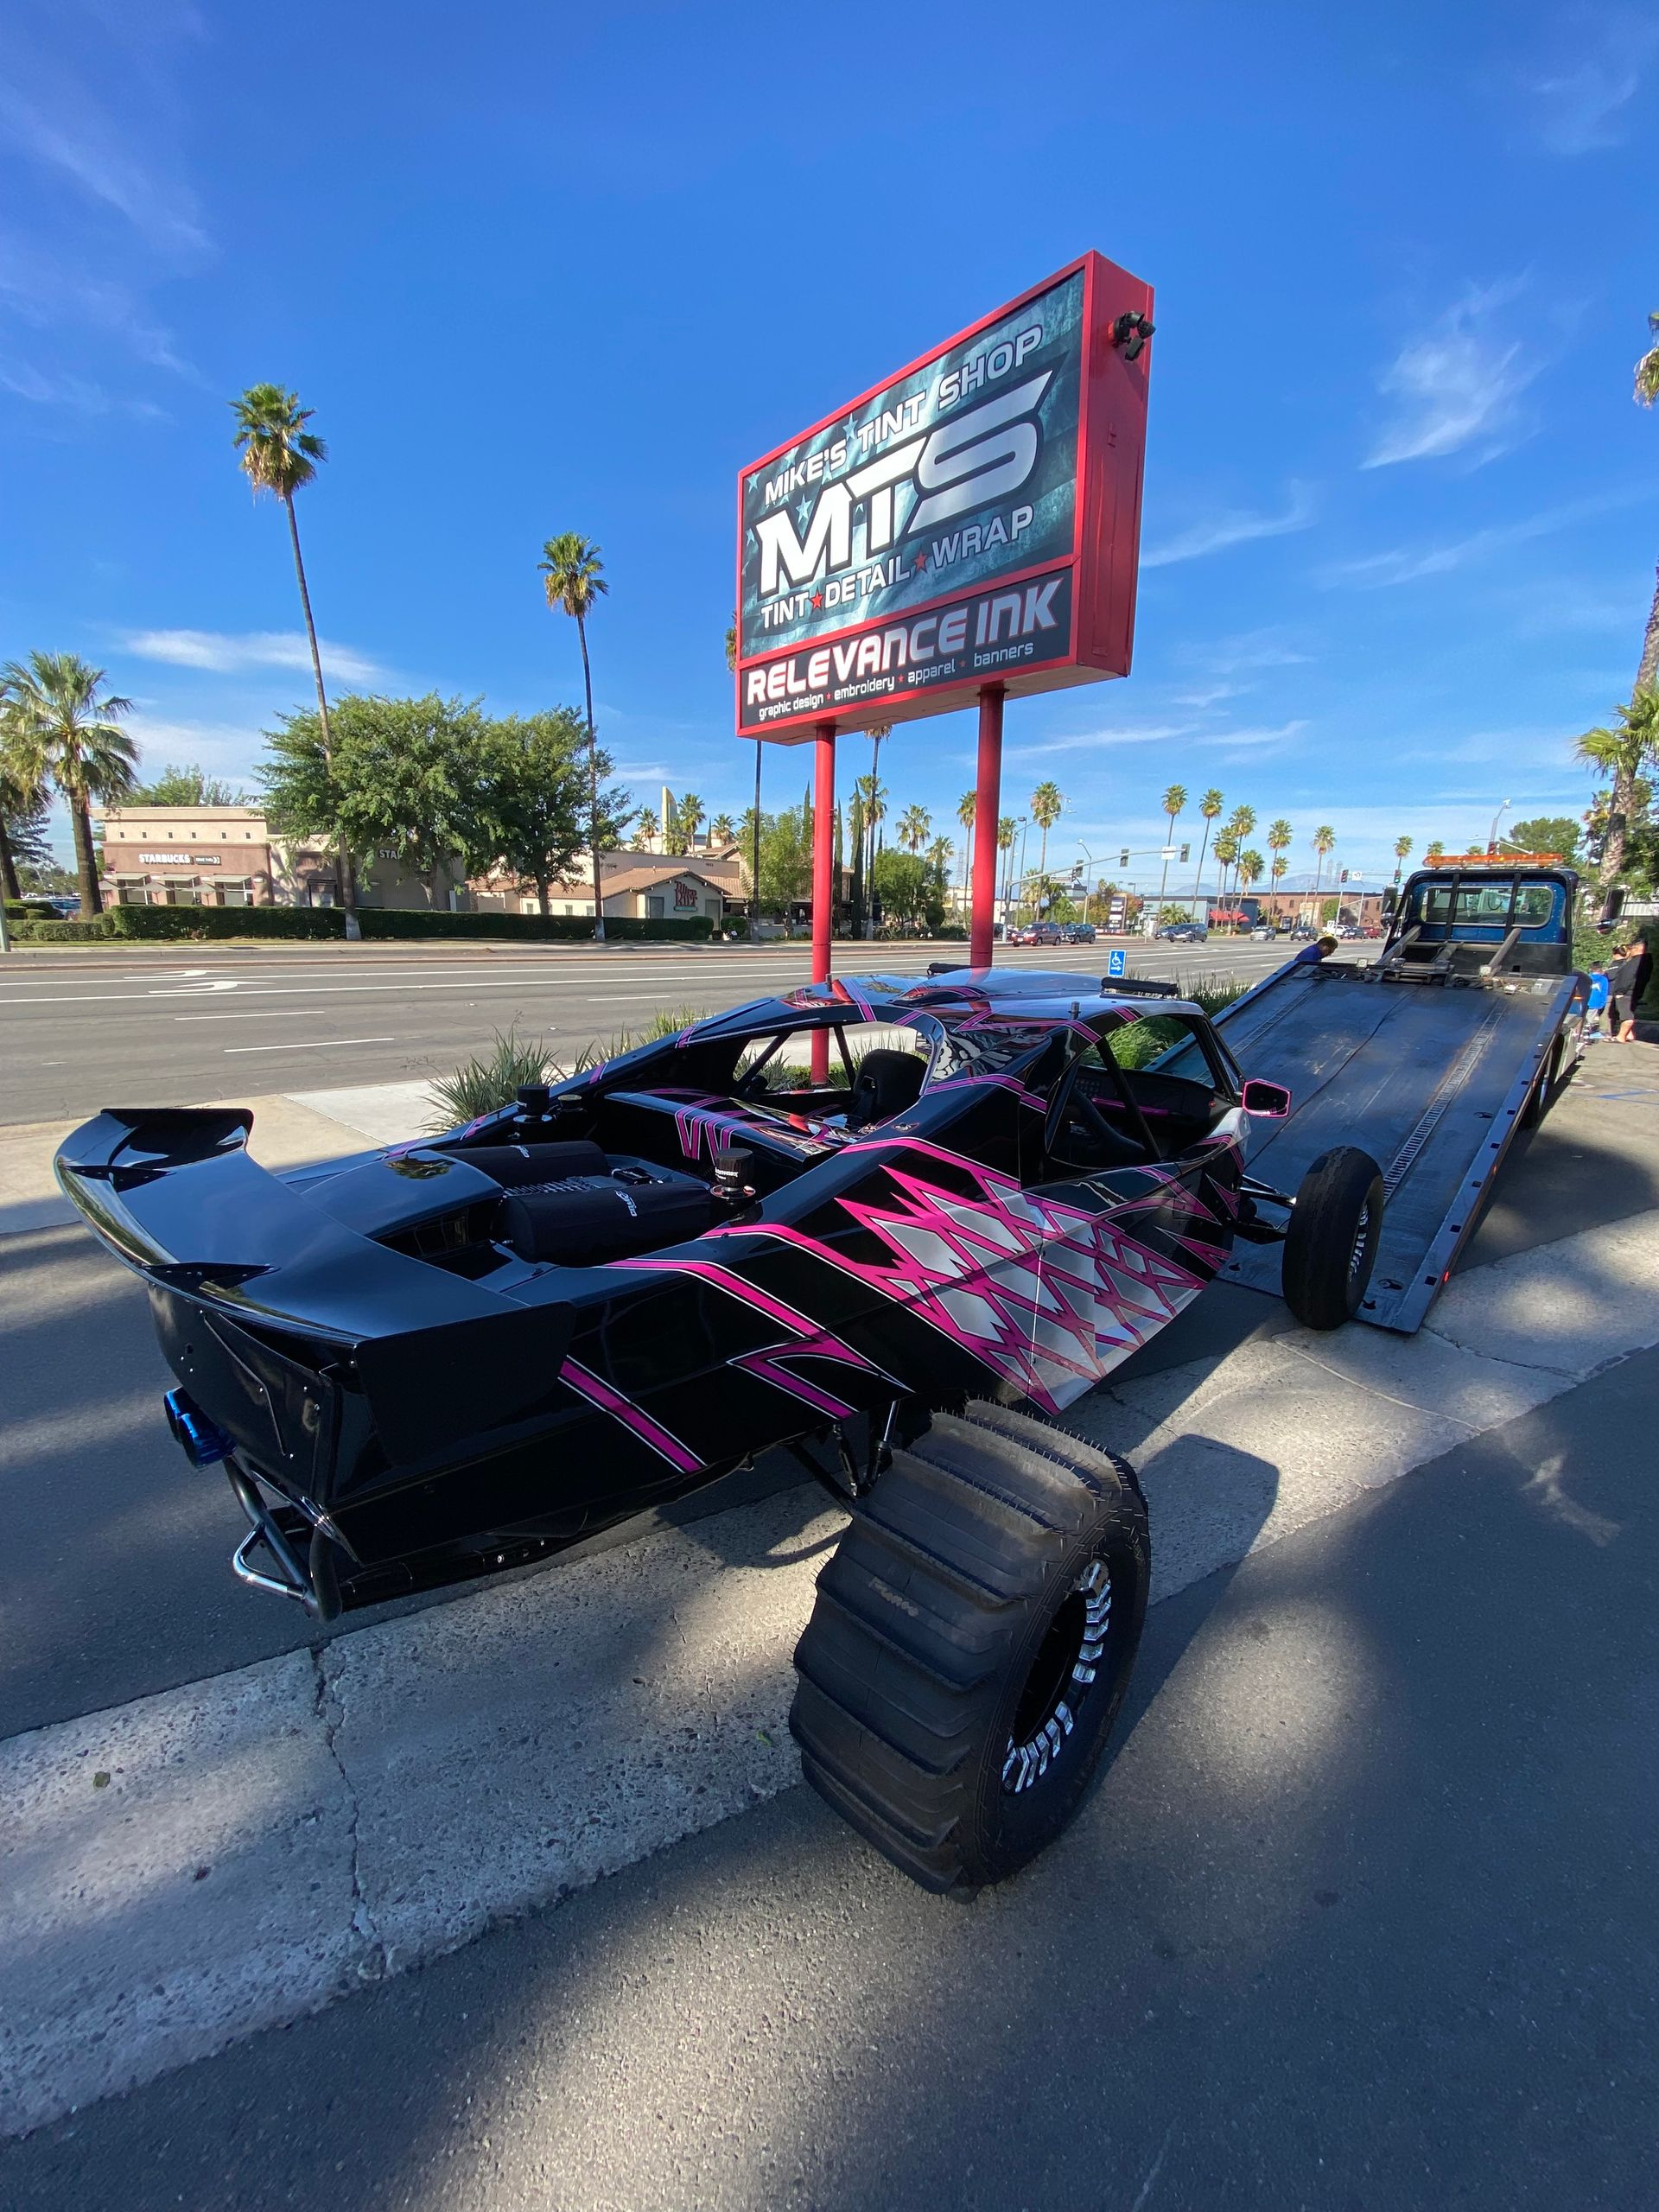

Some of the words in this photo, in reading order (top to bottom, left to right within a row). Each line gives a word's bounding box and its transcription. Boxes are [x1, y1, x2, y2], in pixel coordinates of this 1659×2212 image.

[765, 438, 847, 506] MIKE'S
[856, 391, 926, 453] TINT
[938, 325, 1043, 410] SHOP
[755, 370, 1053, 594] MTS
[760, 591, 810, 629] TINT
[824, 557, 910, 609] DETAIL
[931, 505, 1034, 568] WRAP
[747, 607, 969, 706] RELEVANCE
[759, 700, 791, 721] graphic
[793, 692, 823, 711] design
[834, 676, 895, 701] embroidery
[907, 658, 956, 685] apparel
[974, 642, 1033, 667] banners
[138, 854, 191, 864] STARBUCKS
